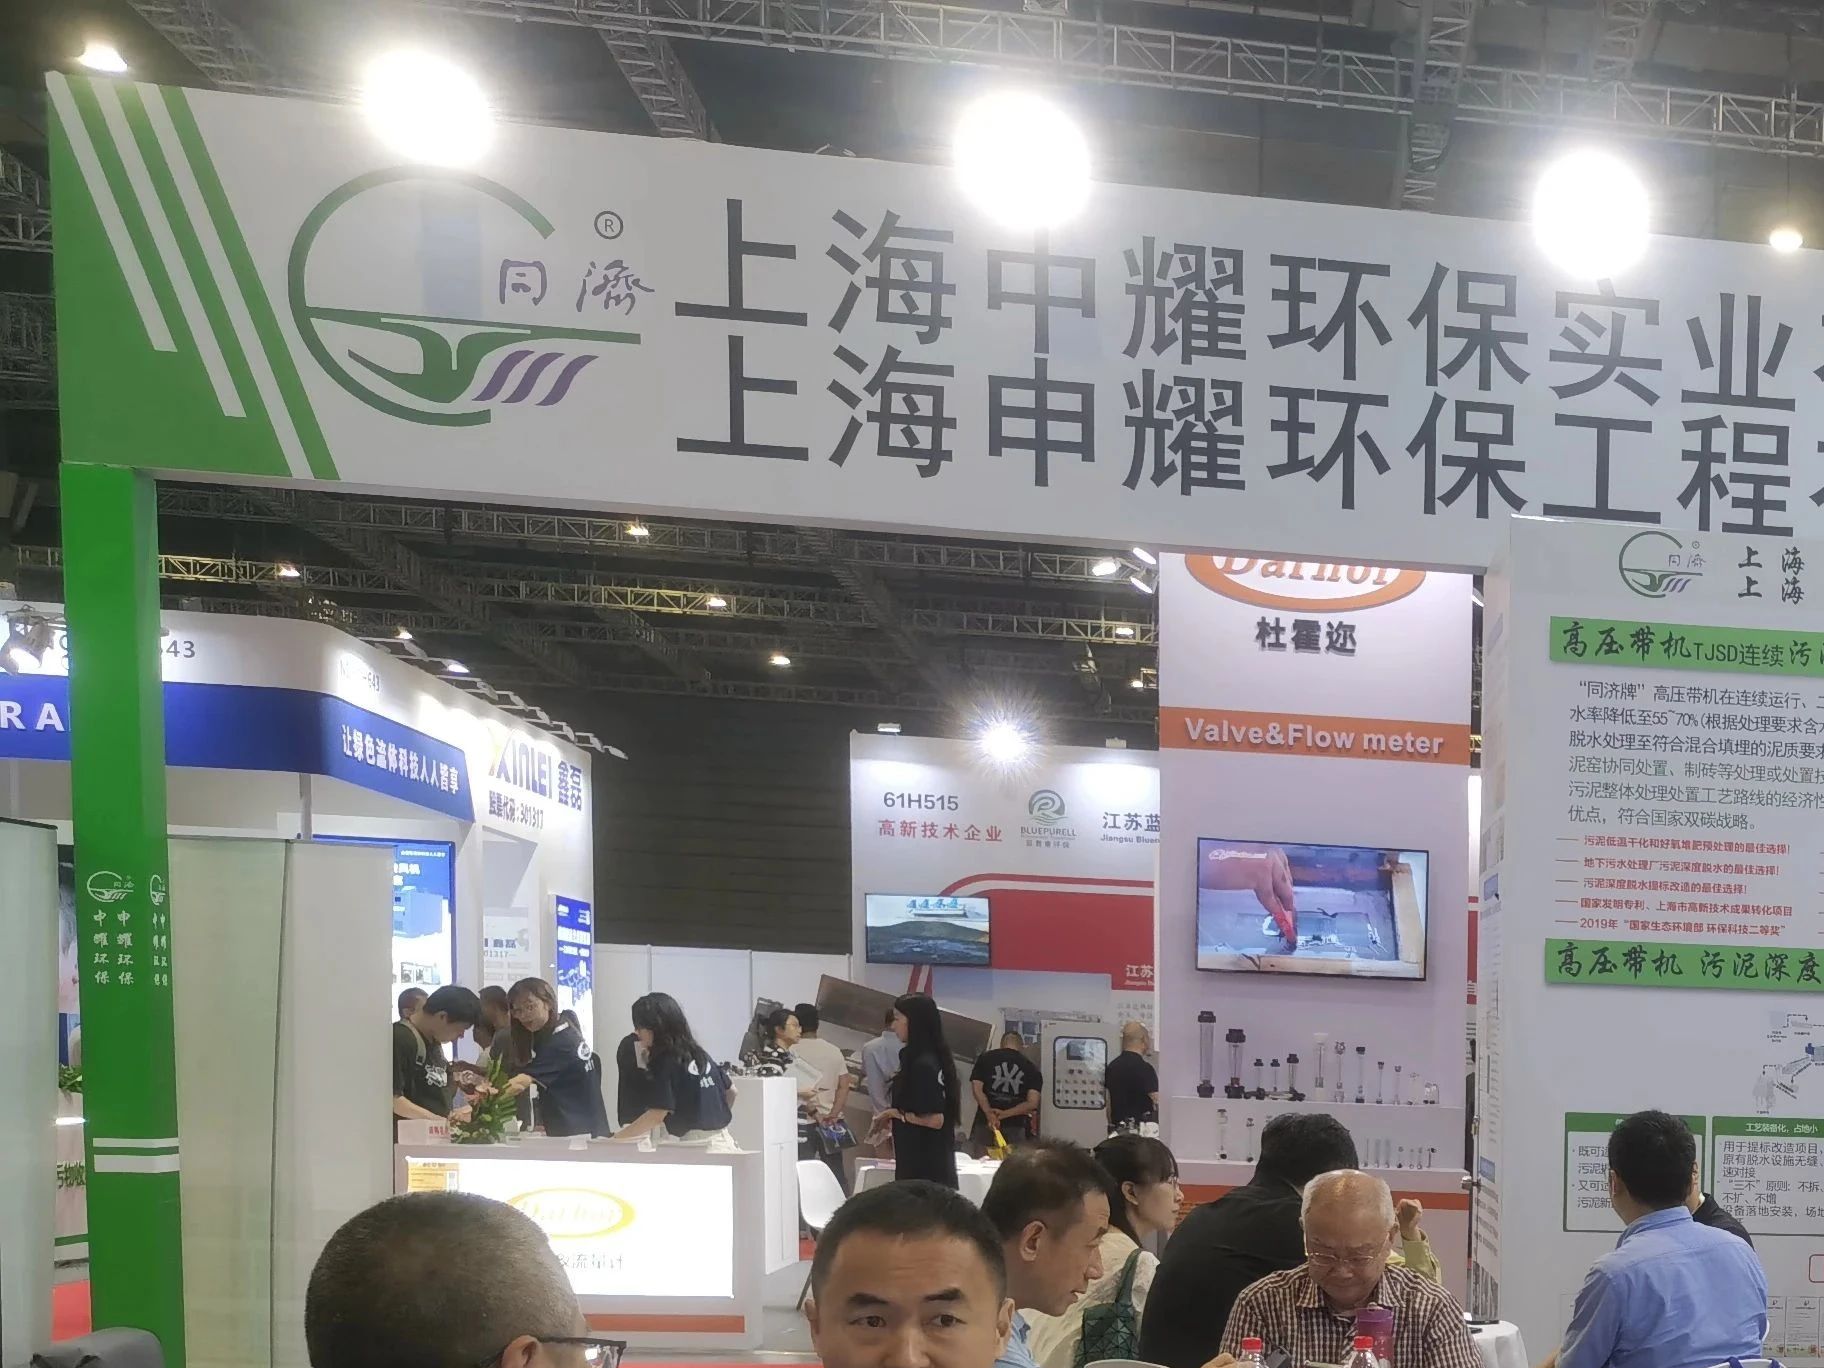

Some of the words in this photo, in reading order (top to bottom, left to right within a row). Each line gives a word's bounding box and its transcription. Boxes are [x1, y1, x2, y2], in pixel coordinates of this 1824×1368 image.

[1255, 616, 1357, 656] 杜霍迩
[1185, 717, 1355, 751] Valve&Flow
[1363, 722, 1444, 755] meter
[883, 791, 959, 811] 61H515
[877, 819, 1003, 843] 高新技术企业
